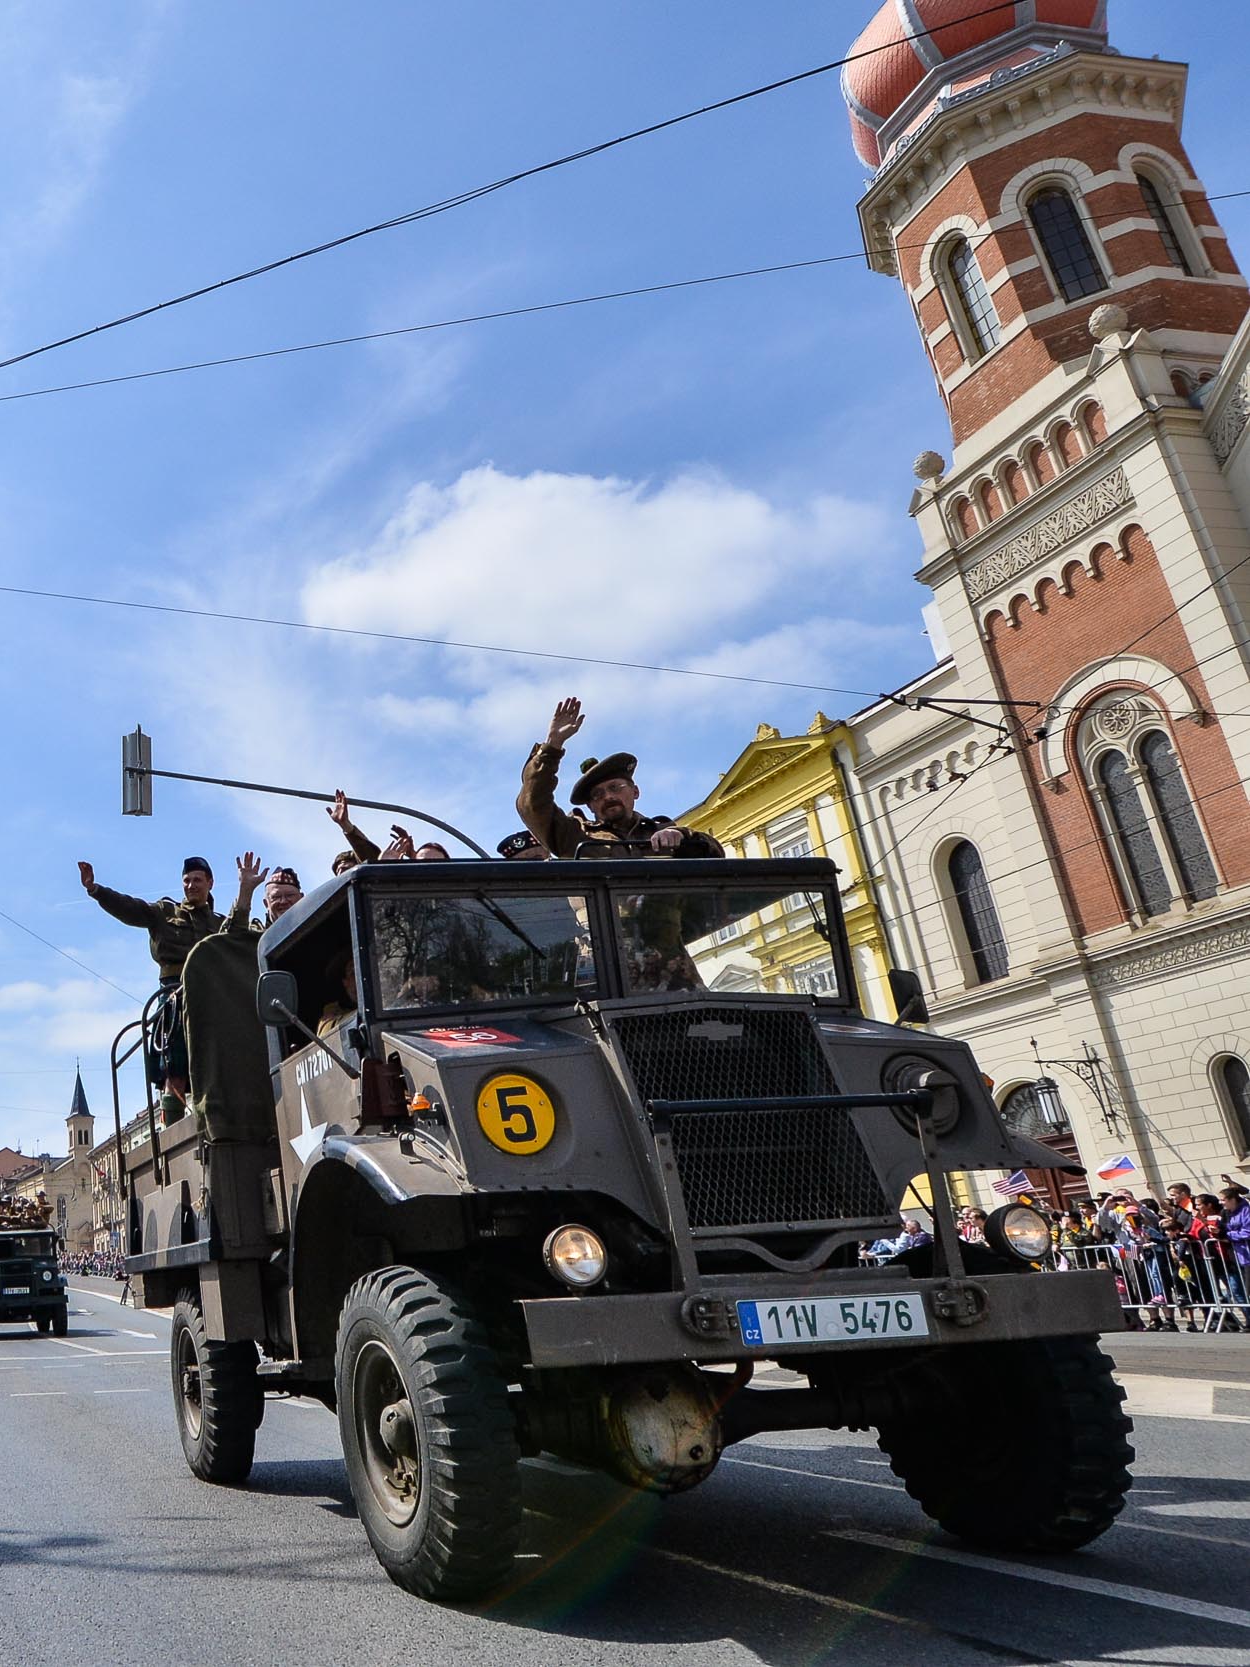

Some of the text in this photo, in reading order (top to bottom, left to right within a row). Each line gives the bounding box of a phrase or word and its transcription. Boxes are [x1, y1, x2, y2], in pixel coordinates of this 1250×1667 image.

[496, 1086, 537, 1143] 5
[746, 1329, 761, 1340] CZ
[767, 1299, 914, 1339] 11V 5476
